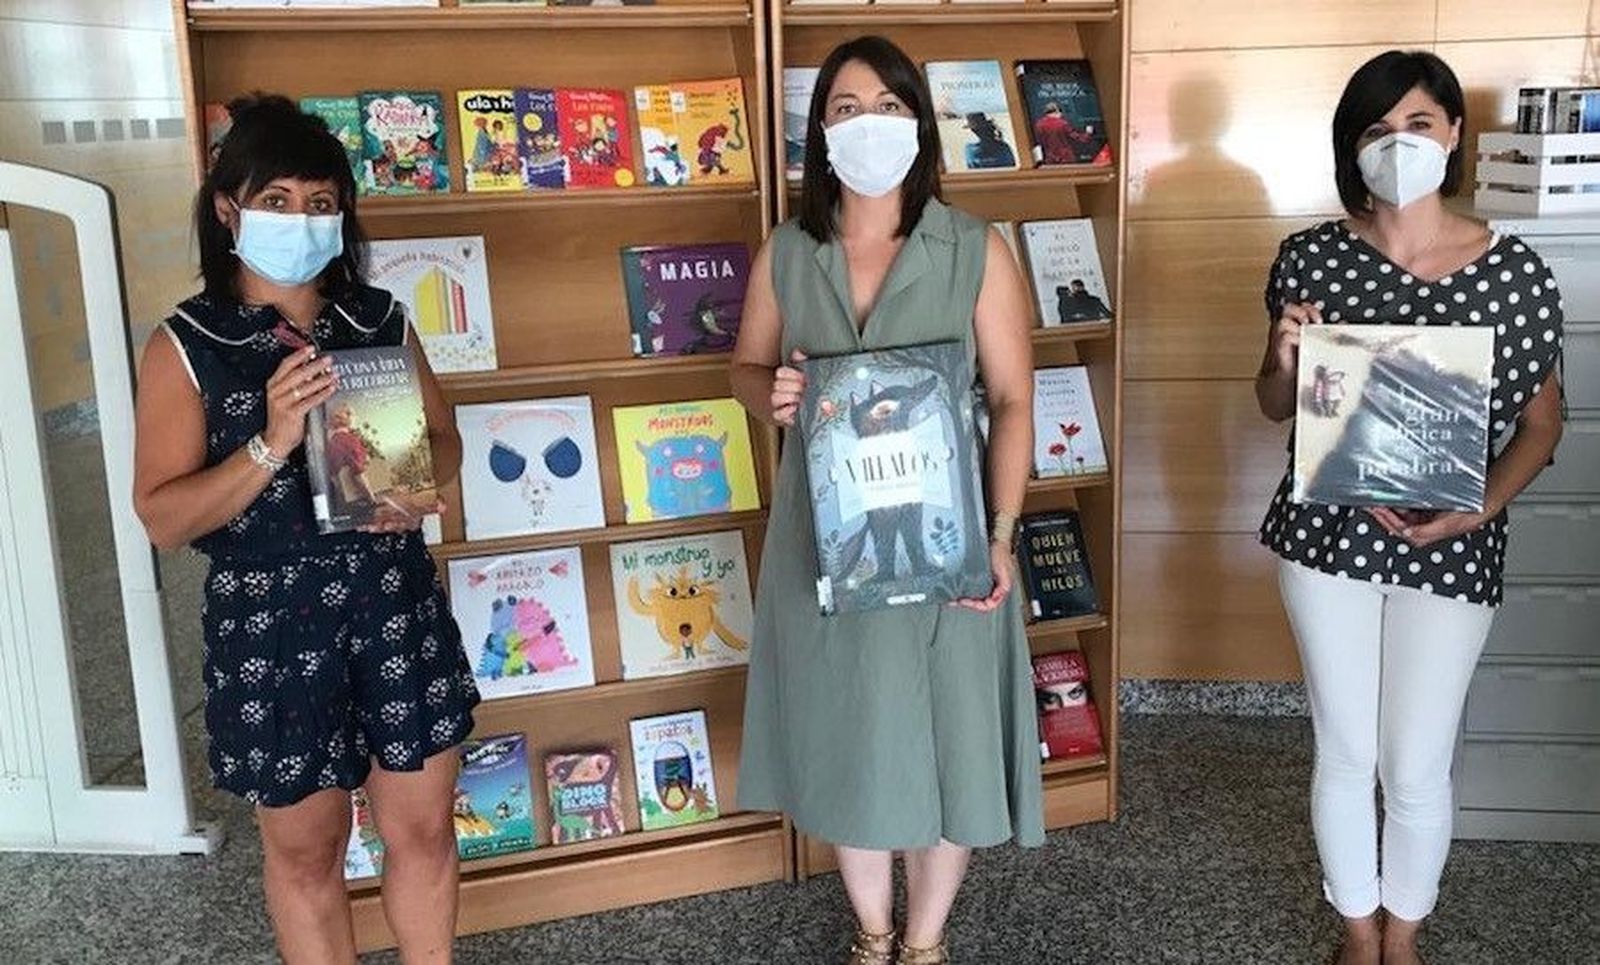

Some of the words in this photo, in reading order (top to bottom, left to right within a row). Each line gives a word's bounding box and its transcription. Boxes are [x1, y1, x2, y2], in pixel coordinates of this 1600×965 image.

[467, 95, 489, 110] ula
[660, 259, 735, 281] MAGIA
[622, 551, 637, 570] Mi
[644, 545, 710, 566] monstruo
[1033, 549, 1081, 567] MUEVE
[703, 561, 712, 578] y
[717, 560, 736, 579] yo
[1041, 574, 1084, 592] HILOS
[561, 783, 607, 800] DINO
